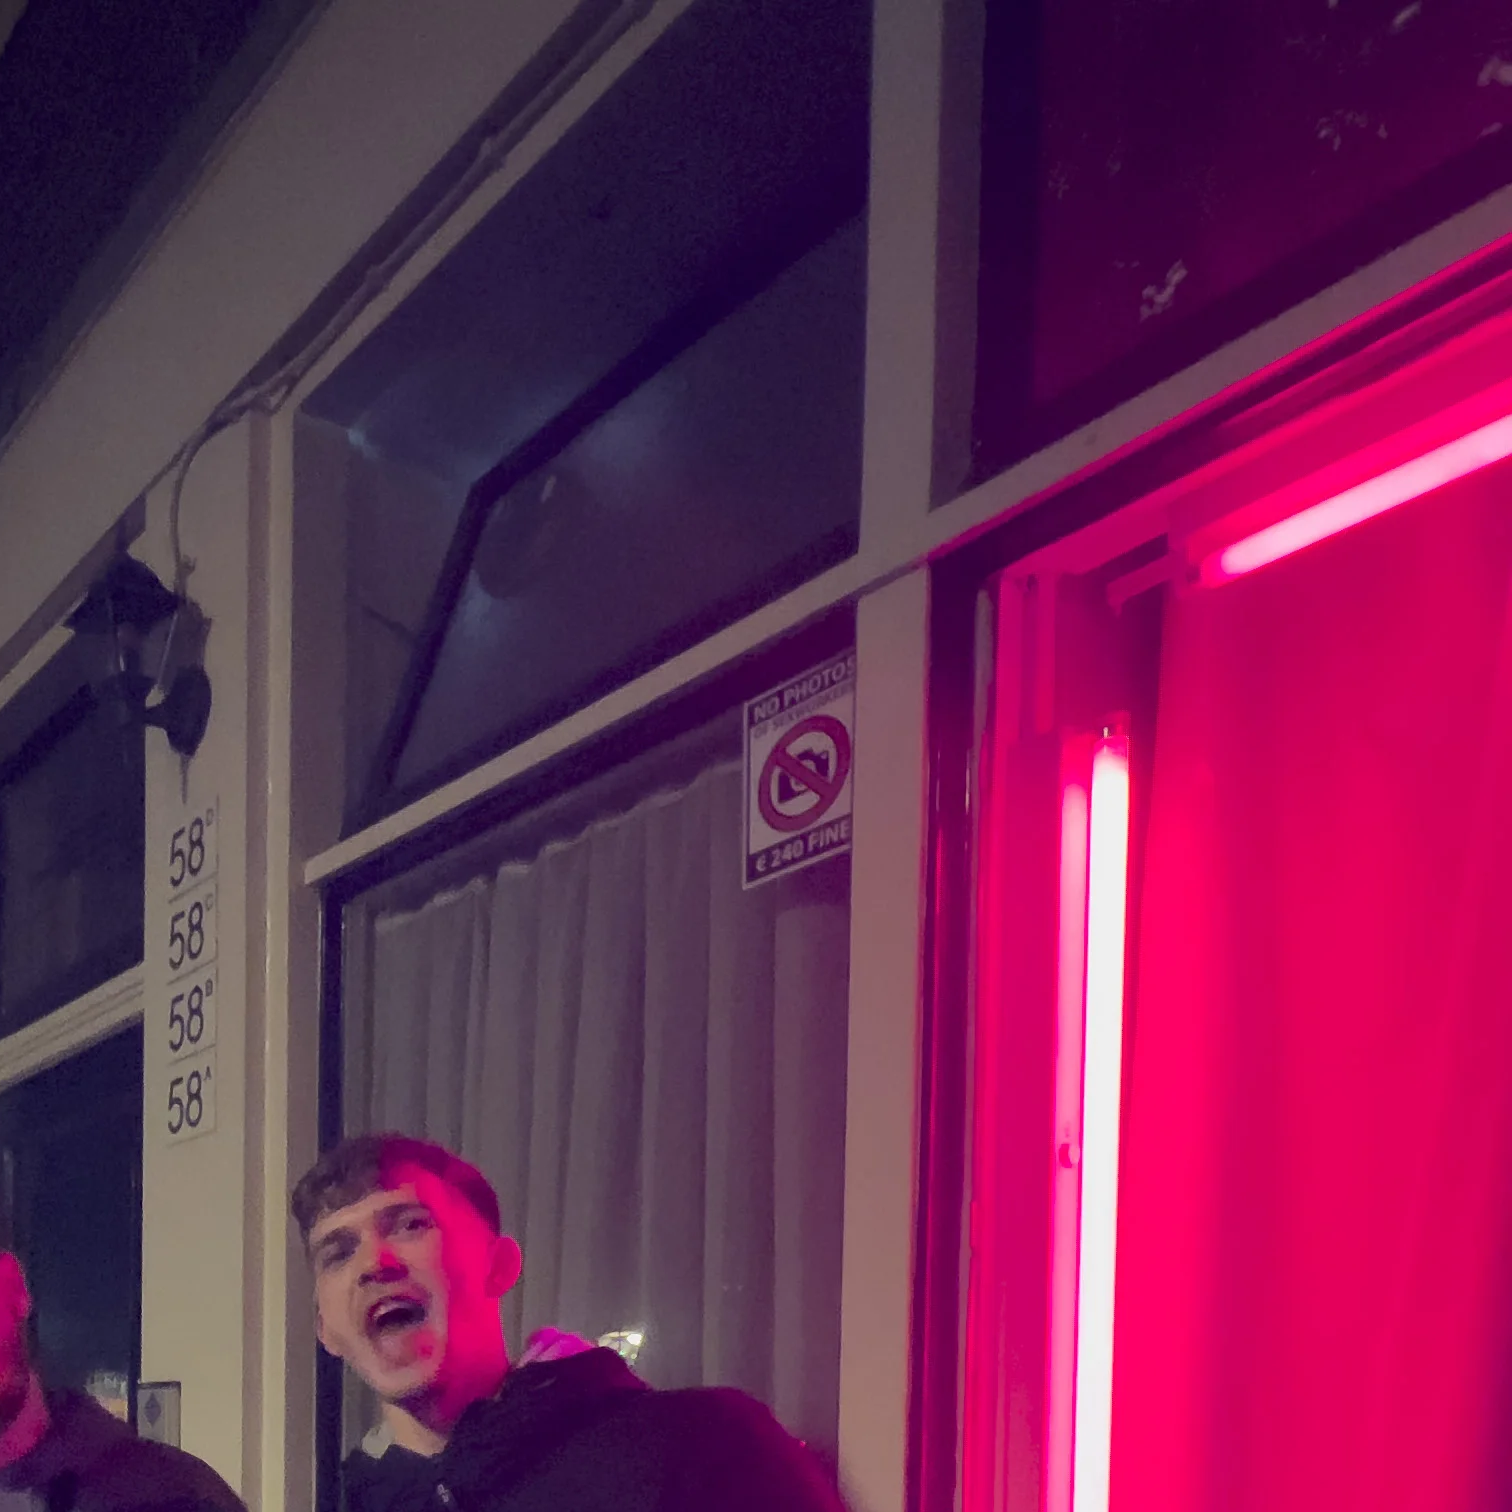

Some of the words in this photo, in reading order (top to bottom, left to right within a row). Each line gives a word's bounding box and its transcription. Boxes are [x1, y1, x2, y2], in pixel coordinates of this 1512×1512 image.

[754, 696, 781, 723] NO
[784, 654, 855, 706] PHOTOS
[771, 839, 804, 868] 240
[808, 818, 851, 853] FINE
